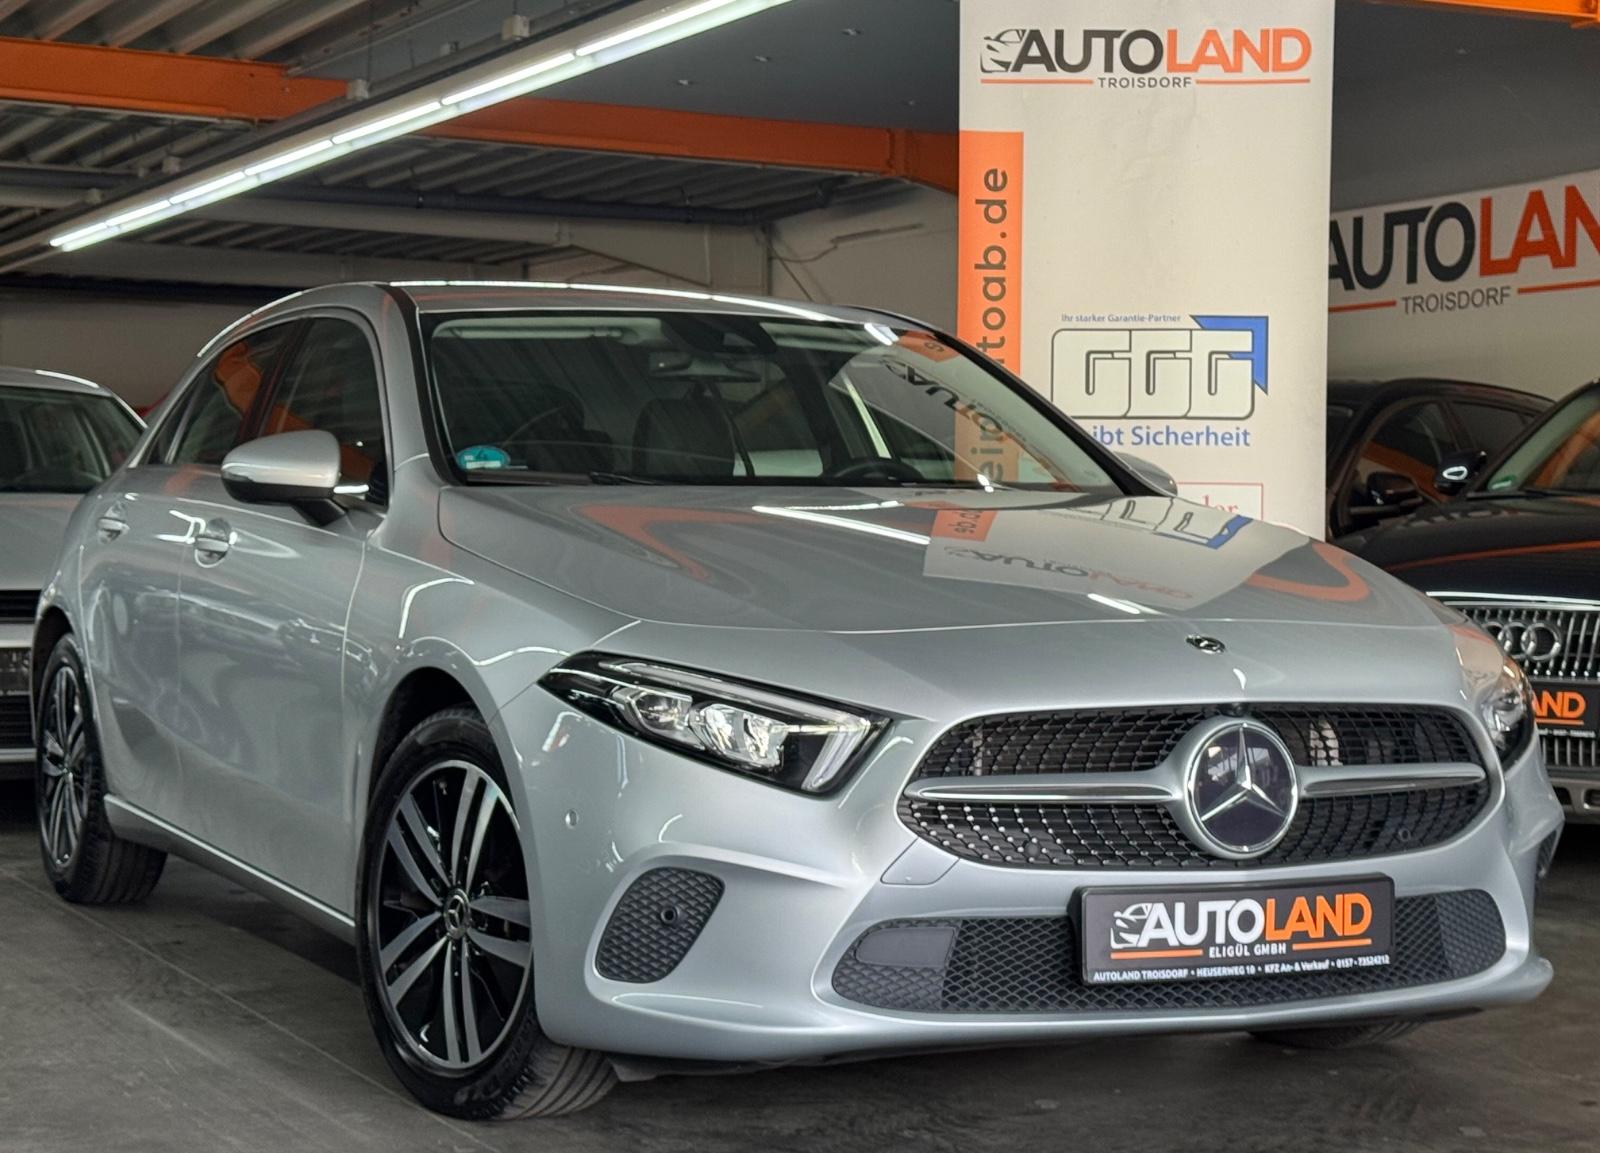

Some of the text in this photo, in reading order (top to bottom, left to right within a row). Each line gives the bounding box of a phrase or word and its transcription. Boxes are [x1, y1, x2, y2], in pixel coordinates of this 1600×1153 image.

[1011, 27, 1312, 74] AUTOLAND
[1097, 76, 1193, 89] TROISDORF
[1401, 286, 1511, 315] TROISDORF
[1061, 313, 1181, 323] Ihr starker Garantie-Partner
[1131, 425, 1250, 447] Sicherheit
[1137, 893, 1373, 947] AUTOLAND
[1208, 942, 1287, 959] ELIGÜL GMBH
[1093, 969, 1140, 981] AUTOLAND
[1142, 968, 1188, 980] TROISDORF
[1196, 965, 1245, 977] HEUSERWEG
[1246, 964, 1256, 975] 10
[1264, 962, 1280, 974] KFZ
[1300, 958, 1330, 971] Verkauf
